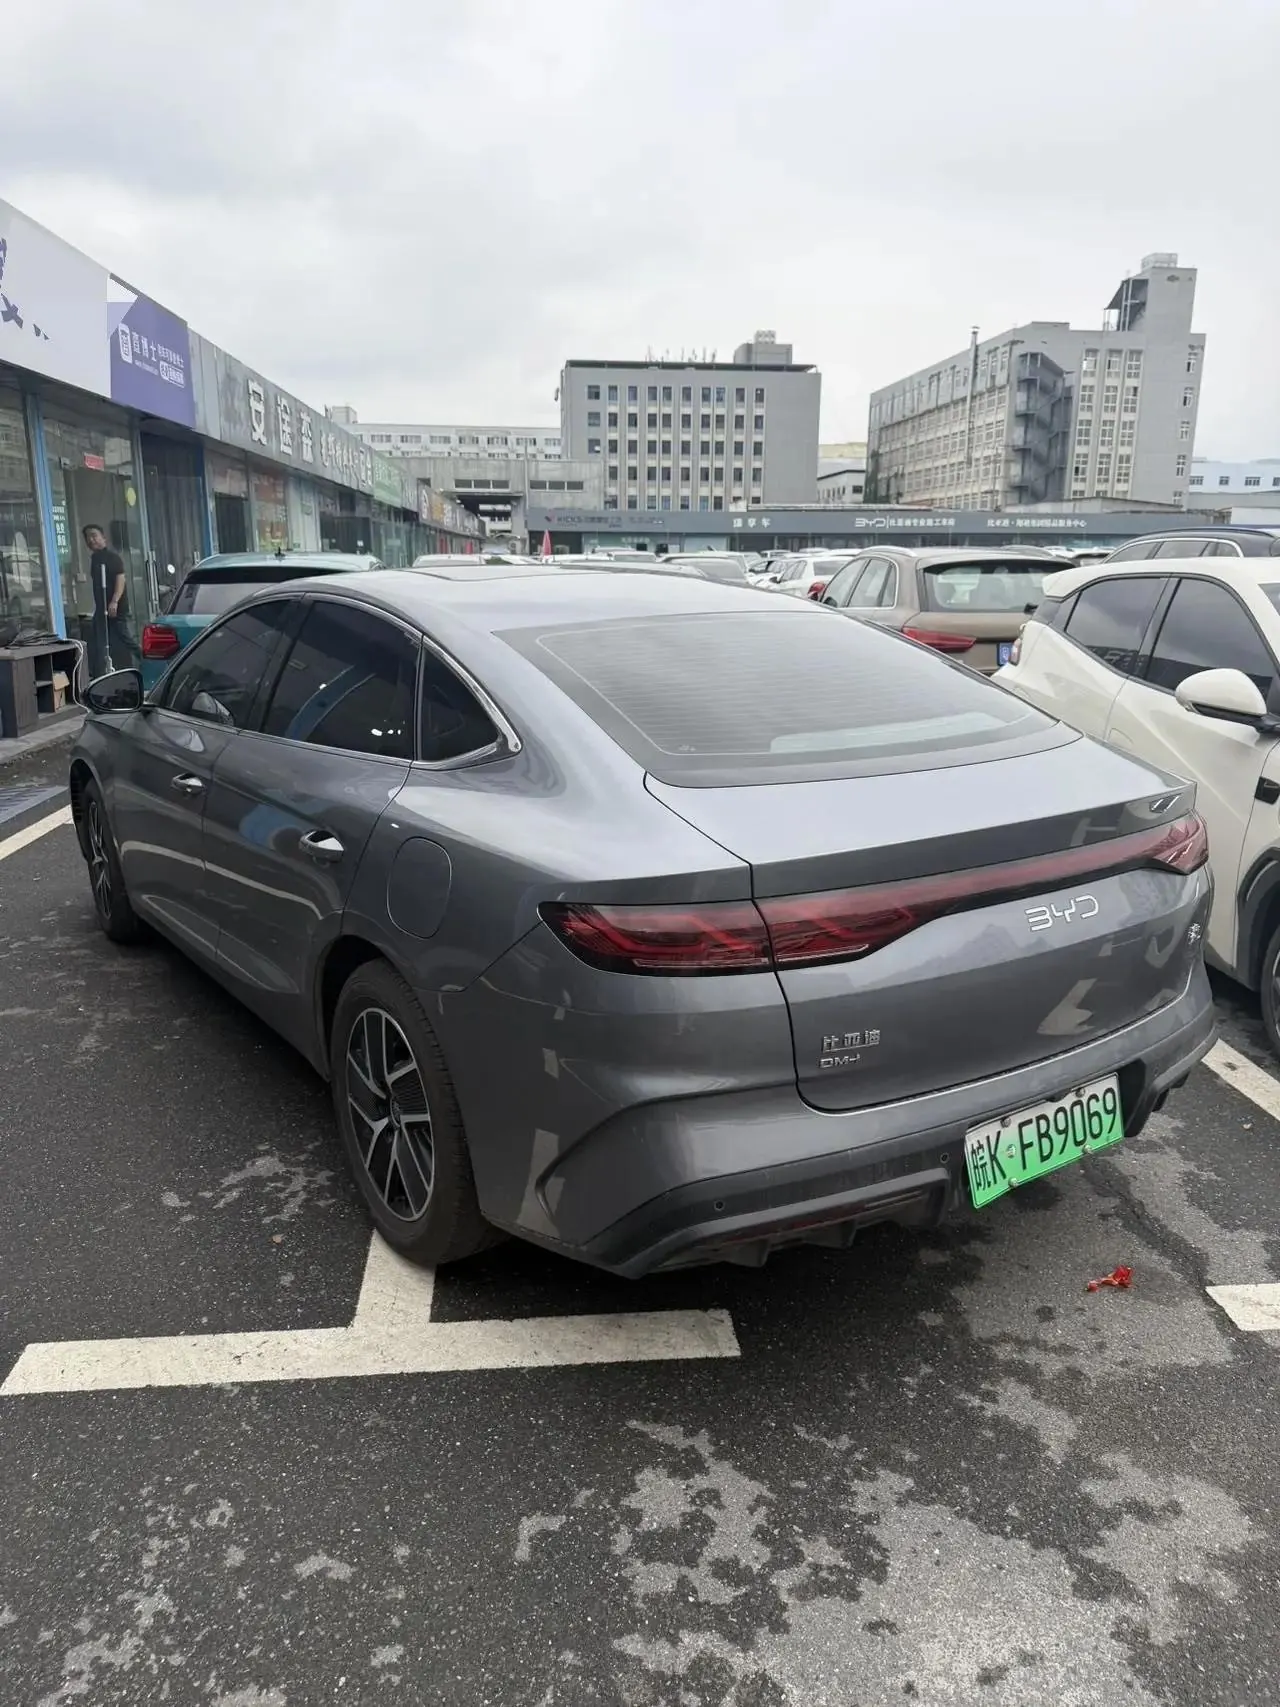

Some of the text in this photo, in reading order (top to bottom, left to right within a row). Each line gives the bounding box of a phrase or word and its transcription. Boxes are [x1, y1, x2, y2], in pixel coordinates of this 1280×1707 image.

[855, 517, 886, 528] BYD
[1025, 894, 1099, 931] BYD
[823, 1029, 881, 1053] 比亚迪
